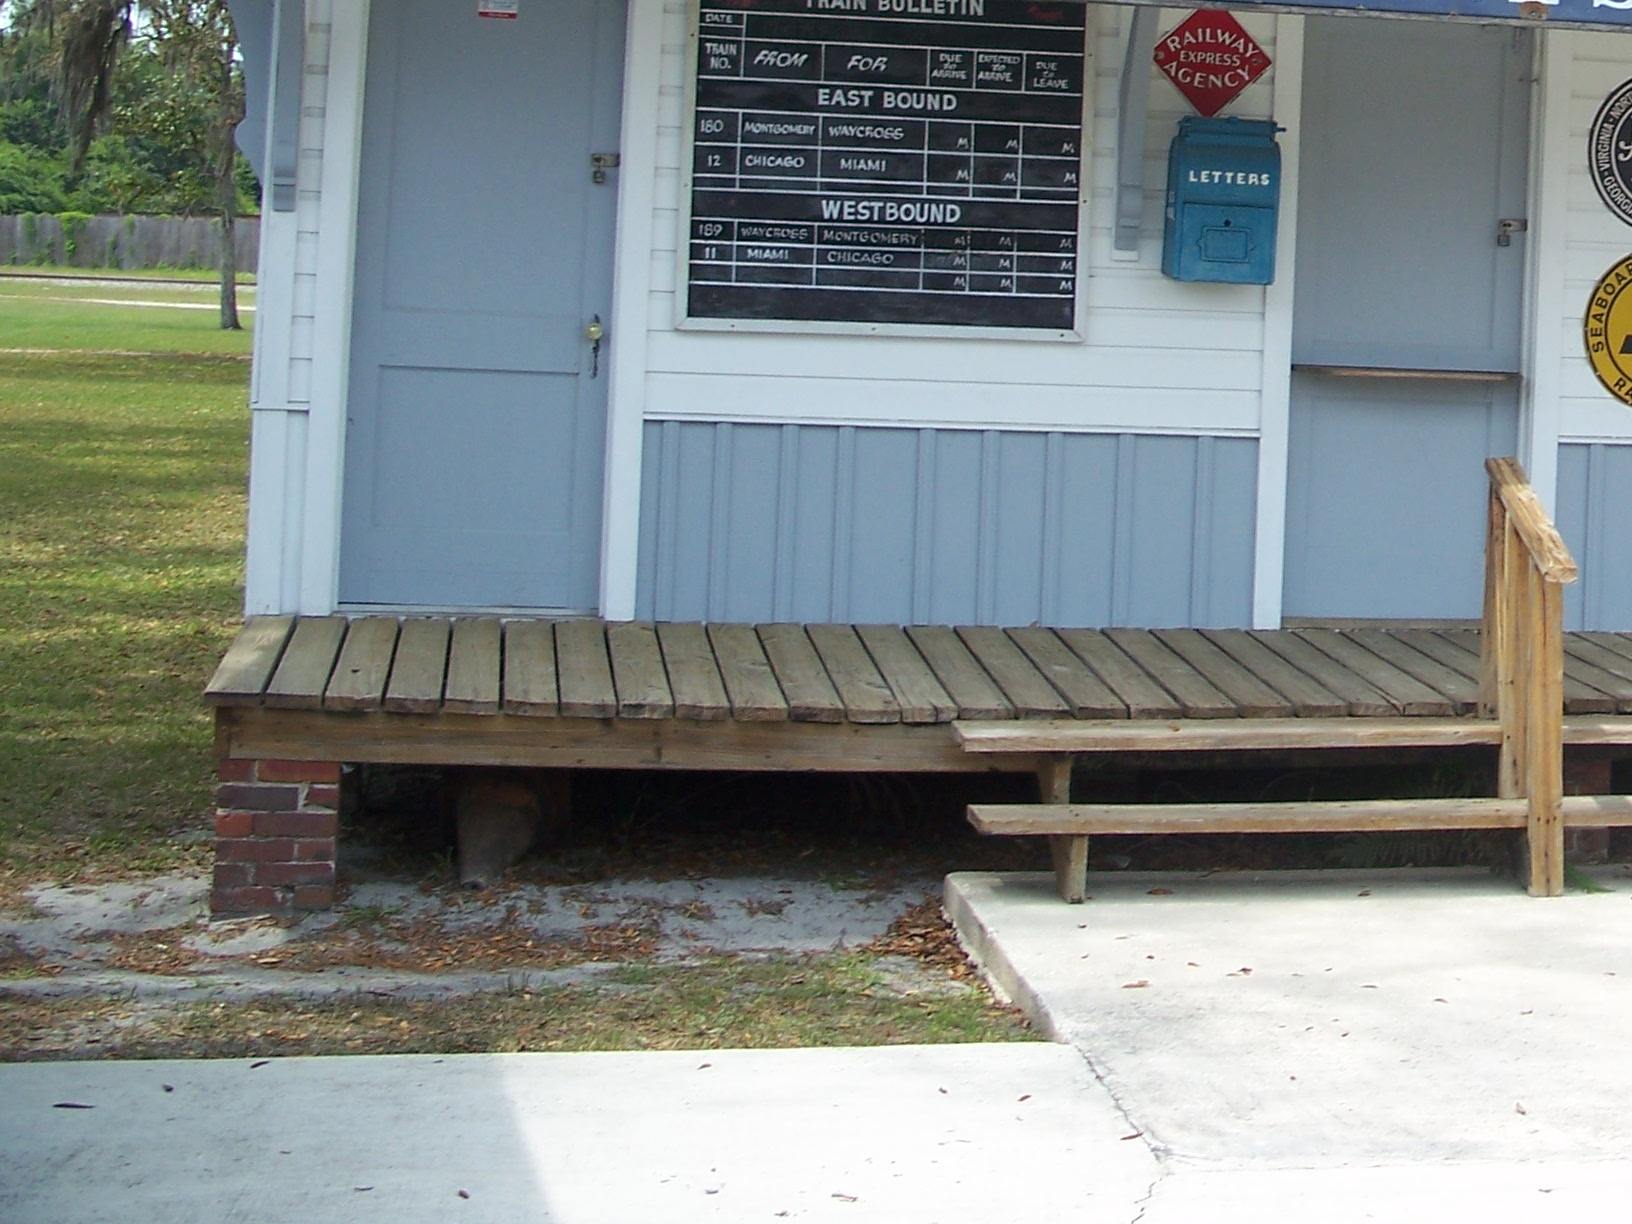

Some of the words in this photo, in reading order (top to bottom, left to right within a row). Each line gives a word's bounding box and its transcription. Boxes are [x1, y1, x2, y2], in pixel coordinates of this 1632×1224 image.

[705, 13, 733, 23] DATE
[705, 42, 737, 56] TRAIN
[1166, 27, 1260, 59] RAILWAY
[710, 57, 732, 70] NO.
[753, 49, 809, 67] FROM
[847, 55, 888, 72] FOR
[940, 53, 963, 63] DUE
[1179, 50, 1241, 68] EXPRESS
[1036, 61, 1058, 71] DUE
[931, 69, 967, 80] ARRIVE
[977, 71, 1013, 82] ARRIVE
[1163, 61, 1251, 89] AGENCY
[1033, 77, 1069, 89] LEAVE
[817, 88, 874, 107] EAST
[883, 91, 957, 111] BOUND
[700, 119, 724, 133] 180
[744, 121, 816, 136] MONTGOMERY
[828, 125, 905, 140] WAYCROSS
[1598, 122, 1614, 171] VIRGINIA
[707, 155, 721, 167] 12
[745, 155, 805, 168] CHICAGO
[840, 158, 886, 172] MIAMI
[1189, 169, 1270, 186] LETTERS
[821, 199, 961, 224] WESTBOUND
[699, 223, 722, 237] 189
[741, 227, 808, 240] WAYCROSS
[823, 229, 918, 245] MONTGOMERY
[704, 247, 716, 259] 11
[747, 247, 789, 260] MIAMI
[827, 251, 894, 264] CHICAGO
